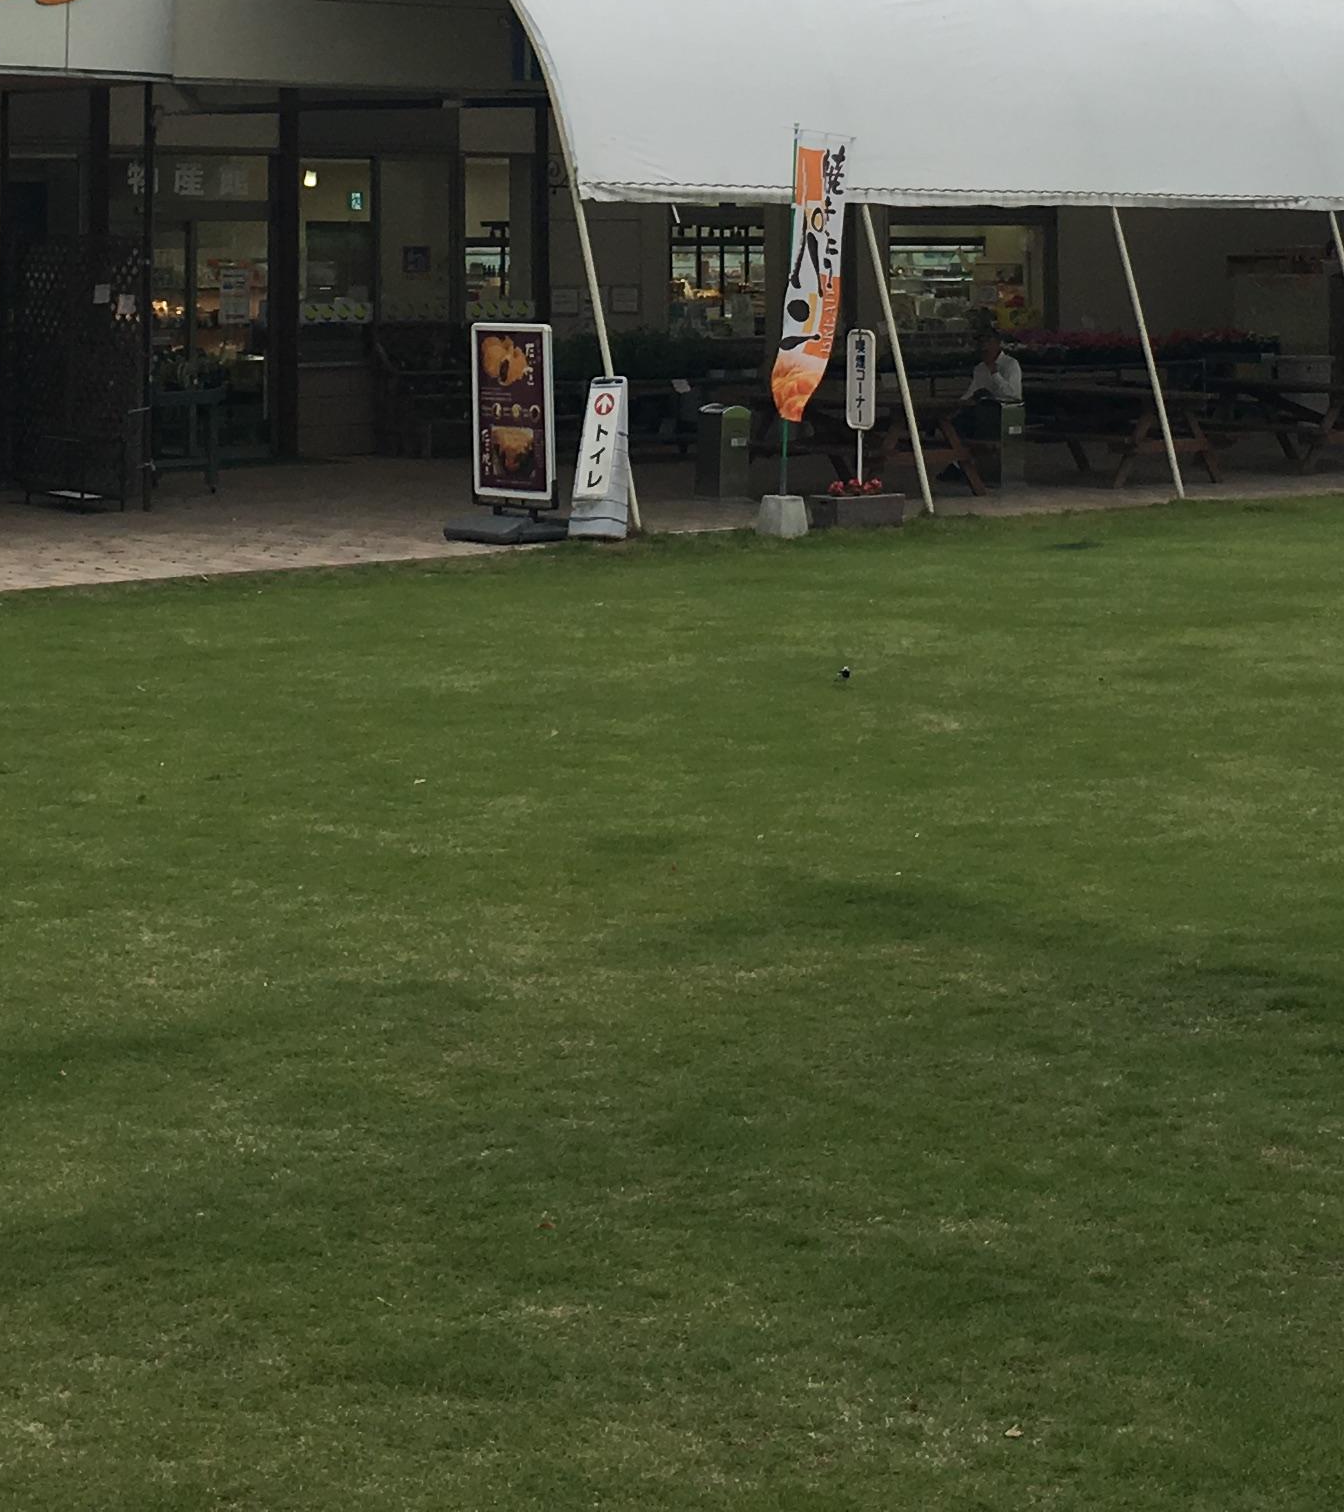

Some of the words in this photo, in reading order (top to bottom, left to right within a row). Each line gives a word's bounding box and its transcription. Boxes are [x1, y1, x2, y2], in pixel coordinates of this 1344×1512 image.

[854, 338, 866, 424] 喫煙コーナー
[586, 423, 609, 488] トイレ
